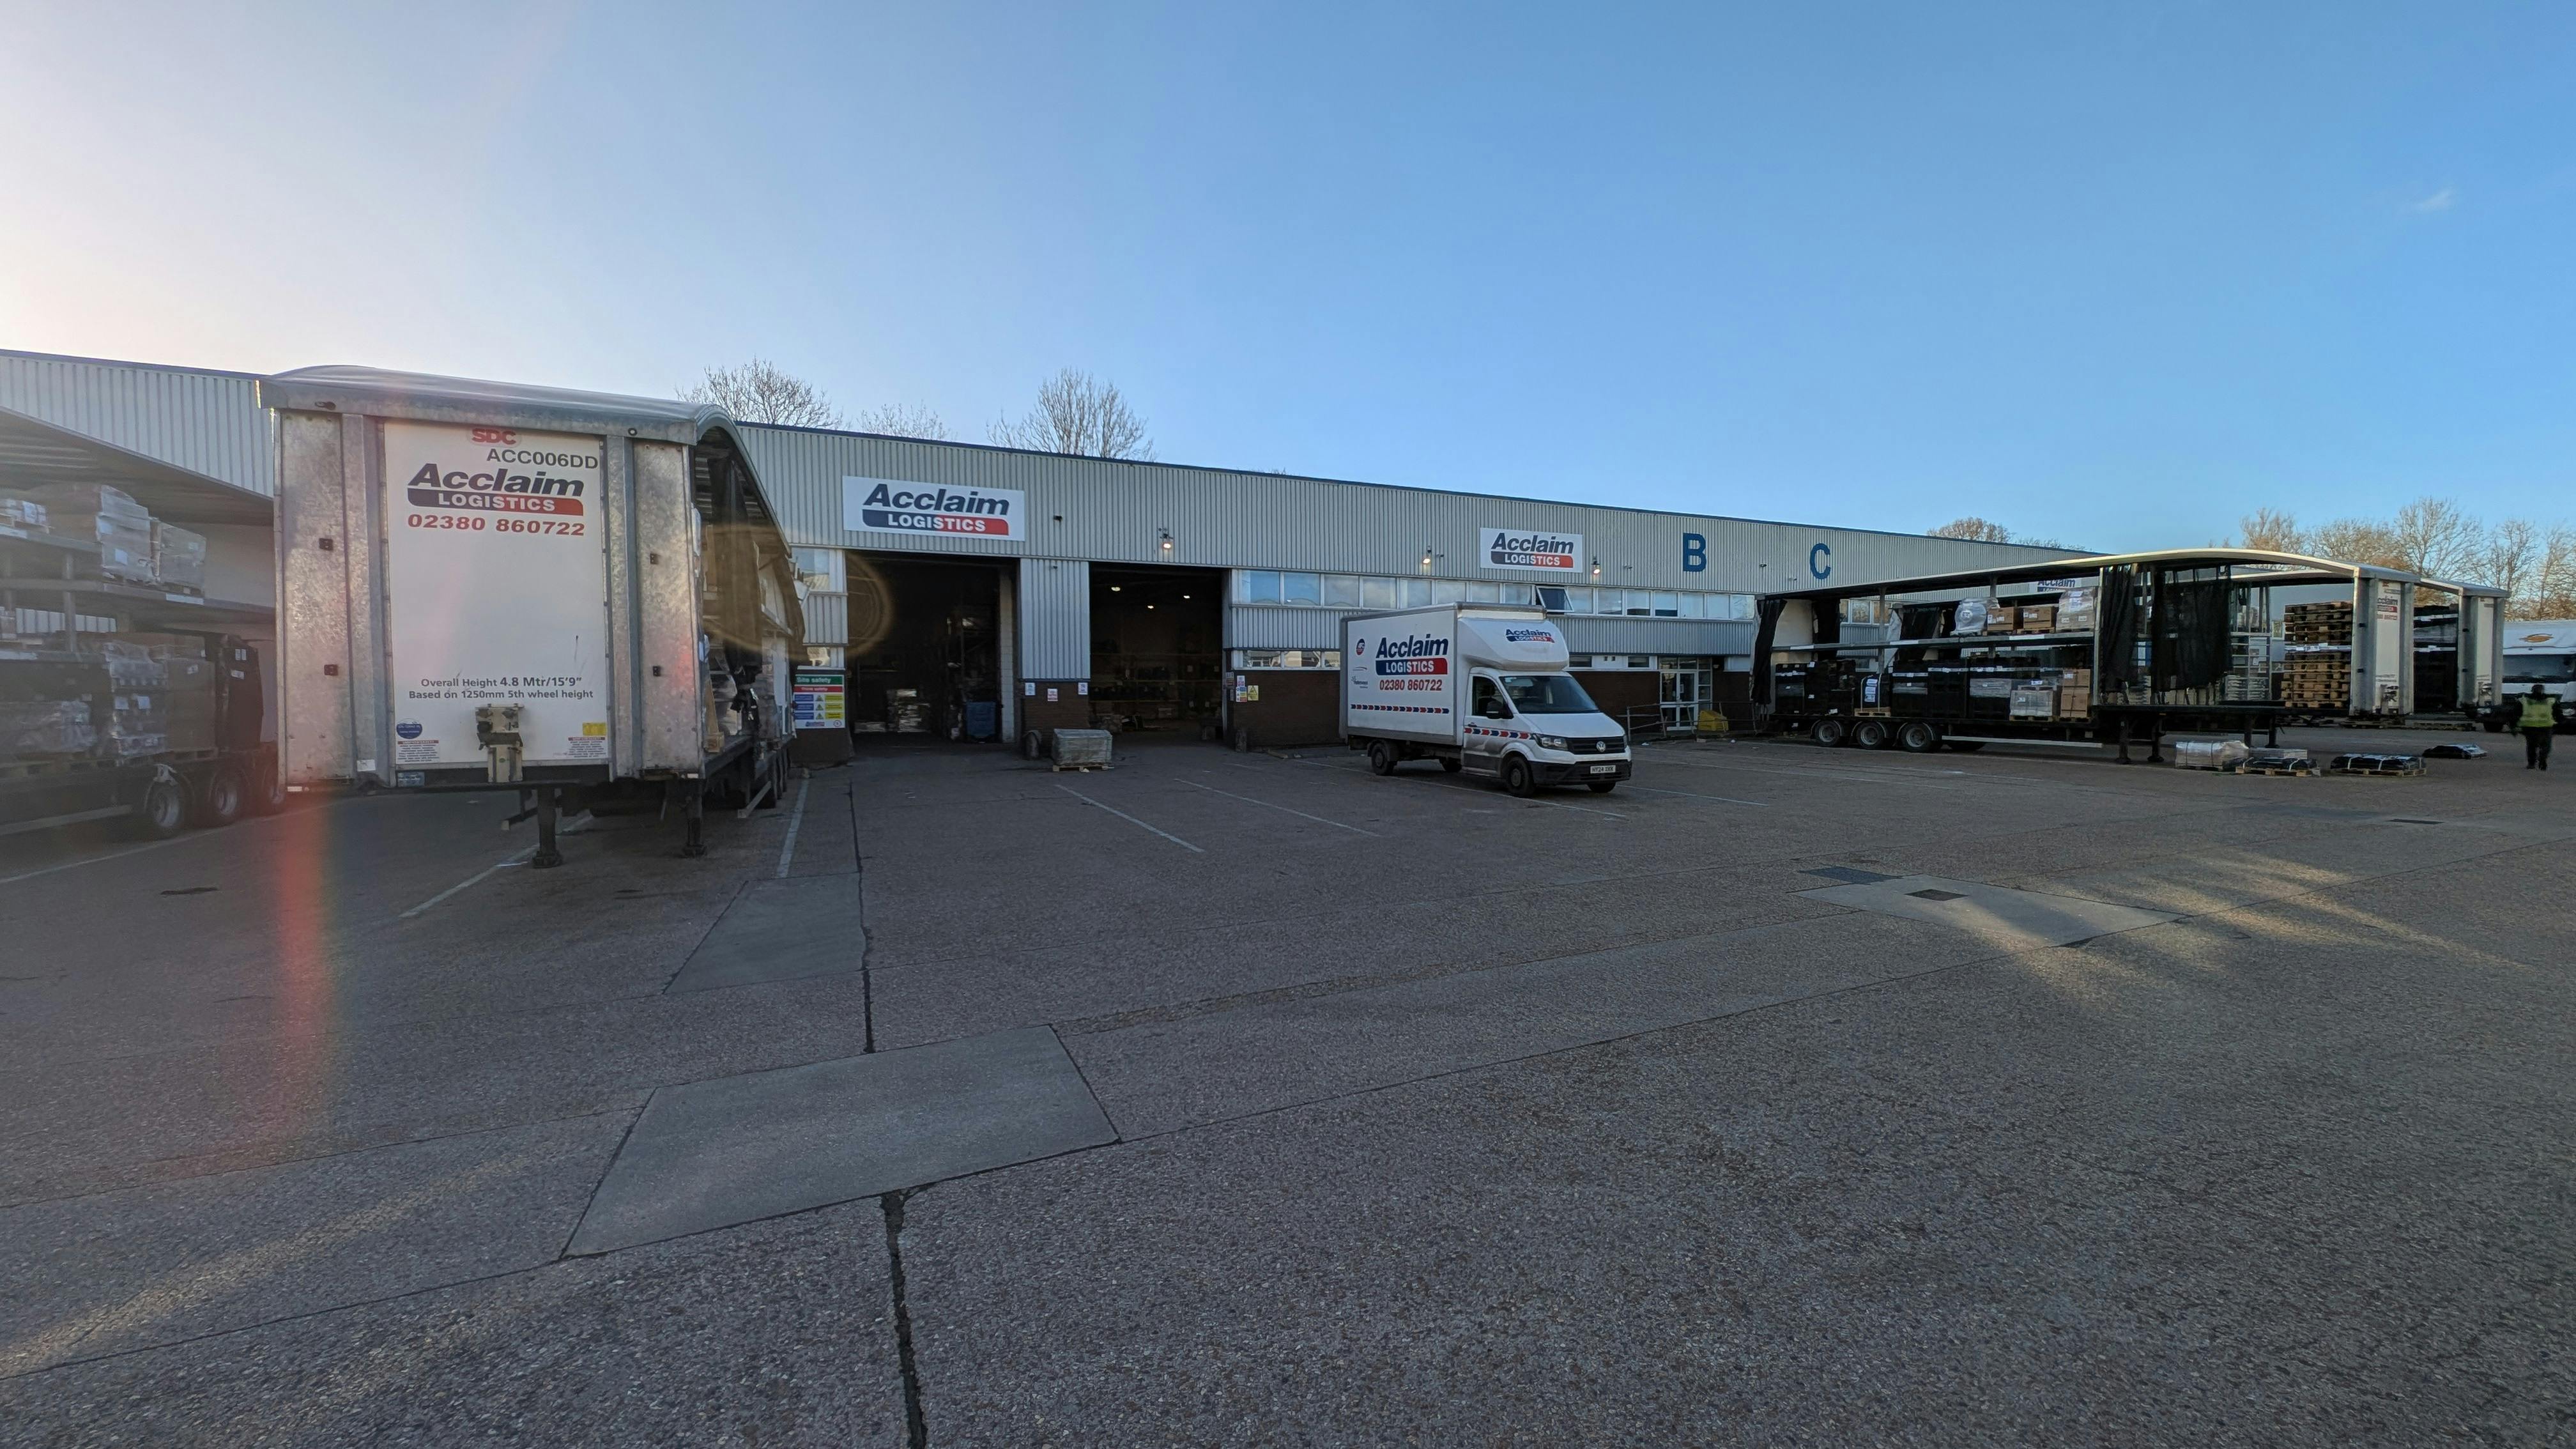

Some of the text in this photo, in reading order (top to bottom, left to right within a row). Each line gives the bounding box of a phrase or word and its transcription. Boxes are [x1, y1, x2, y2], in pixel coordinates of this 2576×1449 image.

[471, 428, 517, 445] SDC
[487, 448, 599, 469] ACC006DD
[408, 463, 585, 497] Acclaim
[438, 493, 555, 512] LOGISTICS
[862, 483, 1009, 516] Acclaim
[408, 514, 585, 536] 02380 860722
[888, 514, 986, 532] LOGISTICS
[1491, 532, 1574, 554] Acclaim
[1683, 532, 1706, 572] B
[1505, 554, 1560, 565] LOGISTICS
[1809, 543, 1831, 579] C
[1376, 634, 1449, 658] Acclaim
[1386, 661, 1434, 673] LOGISTICS
[421, 678, 459, 687] Overall
[463, 678, 497, 688] Height
[500, 677, 519, 686] 4.8
[1379, 679, 1405, 691] 02380
[1407, 679, 1443, 691] 860722
[409, 691, 441, 699] Based
[461, 690, 505, 699] 1250mm
[508, 690, 525, 698] 5th
[527, 689, 558, 698] wheel
[562, 689, 594, 700] height
